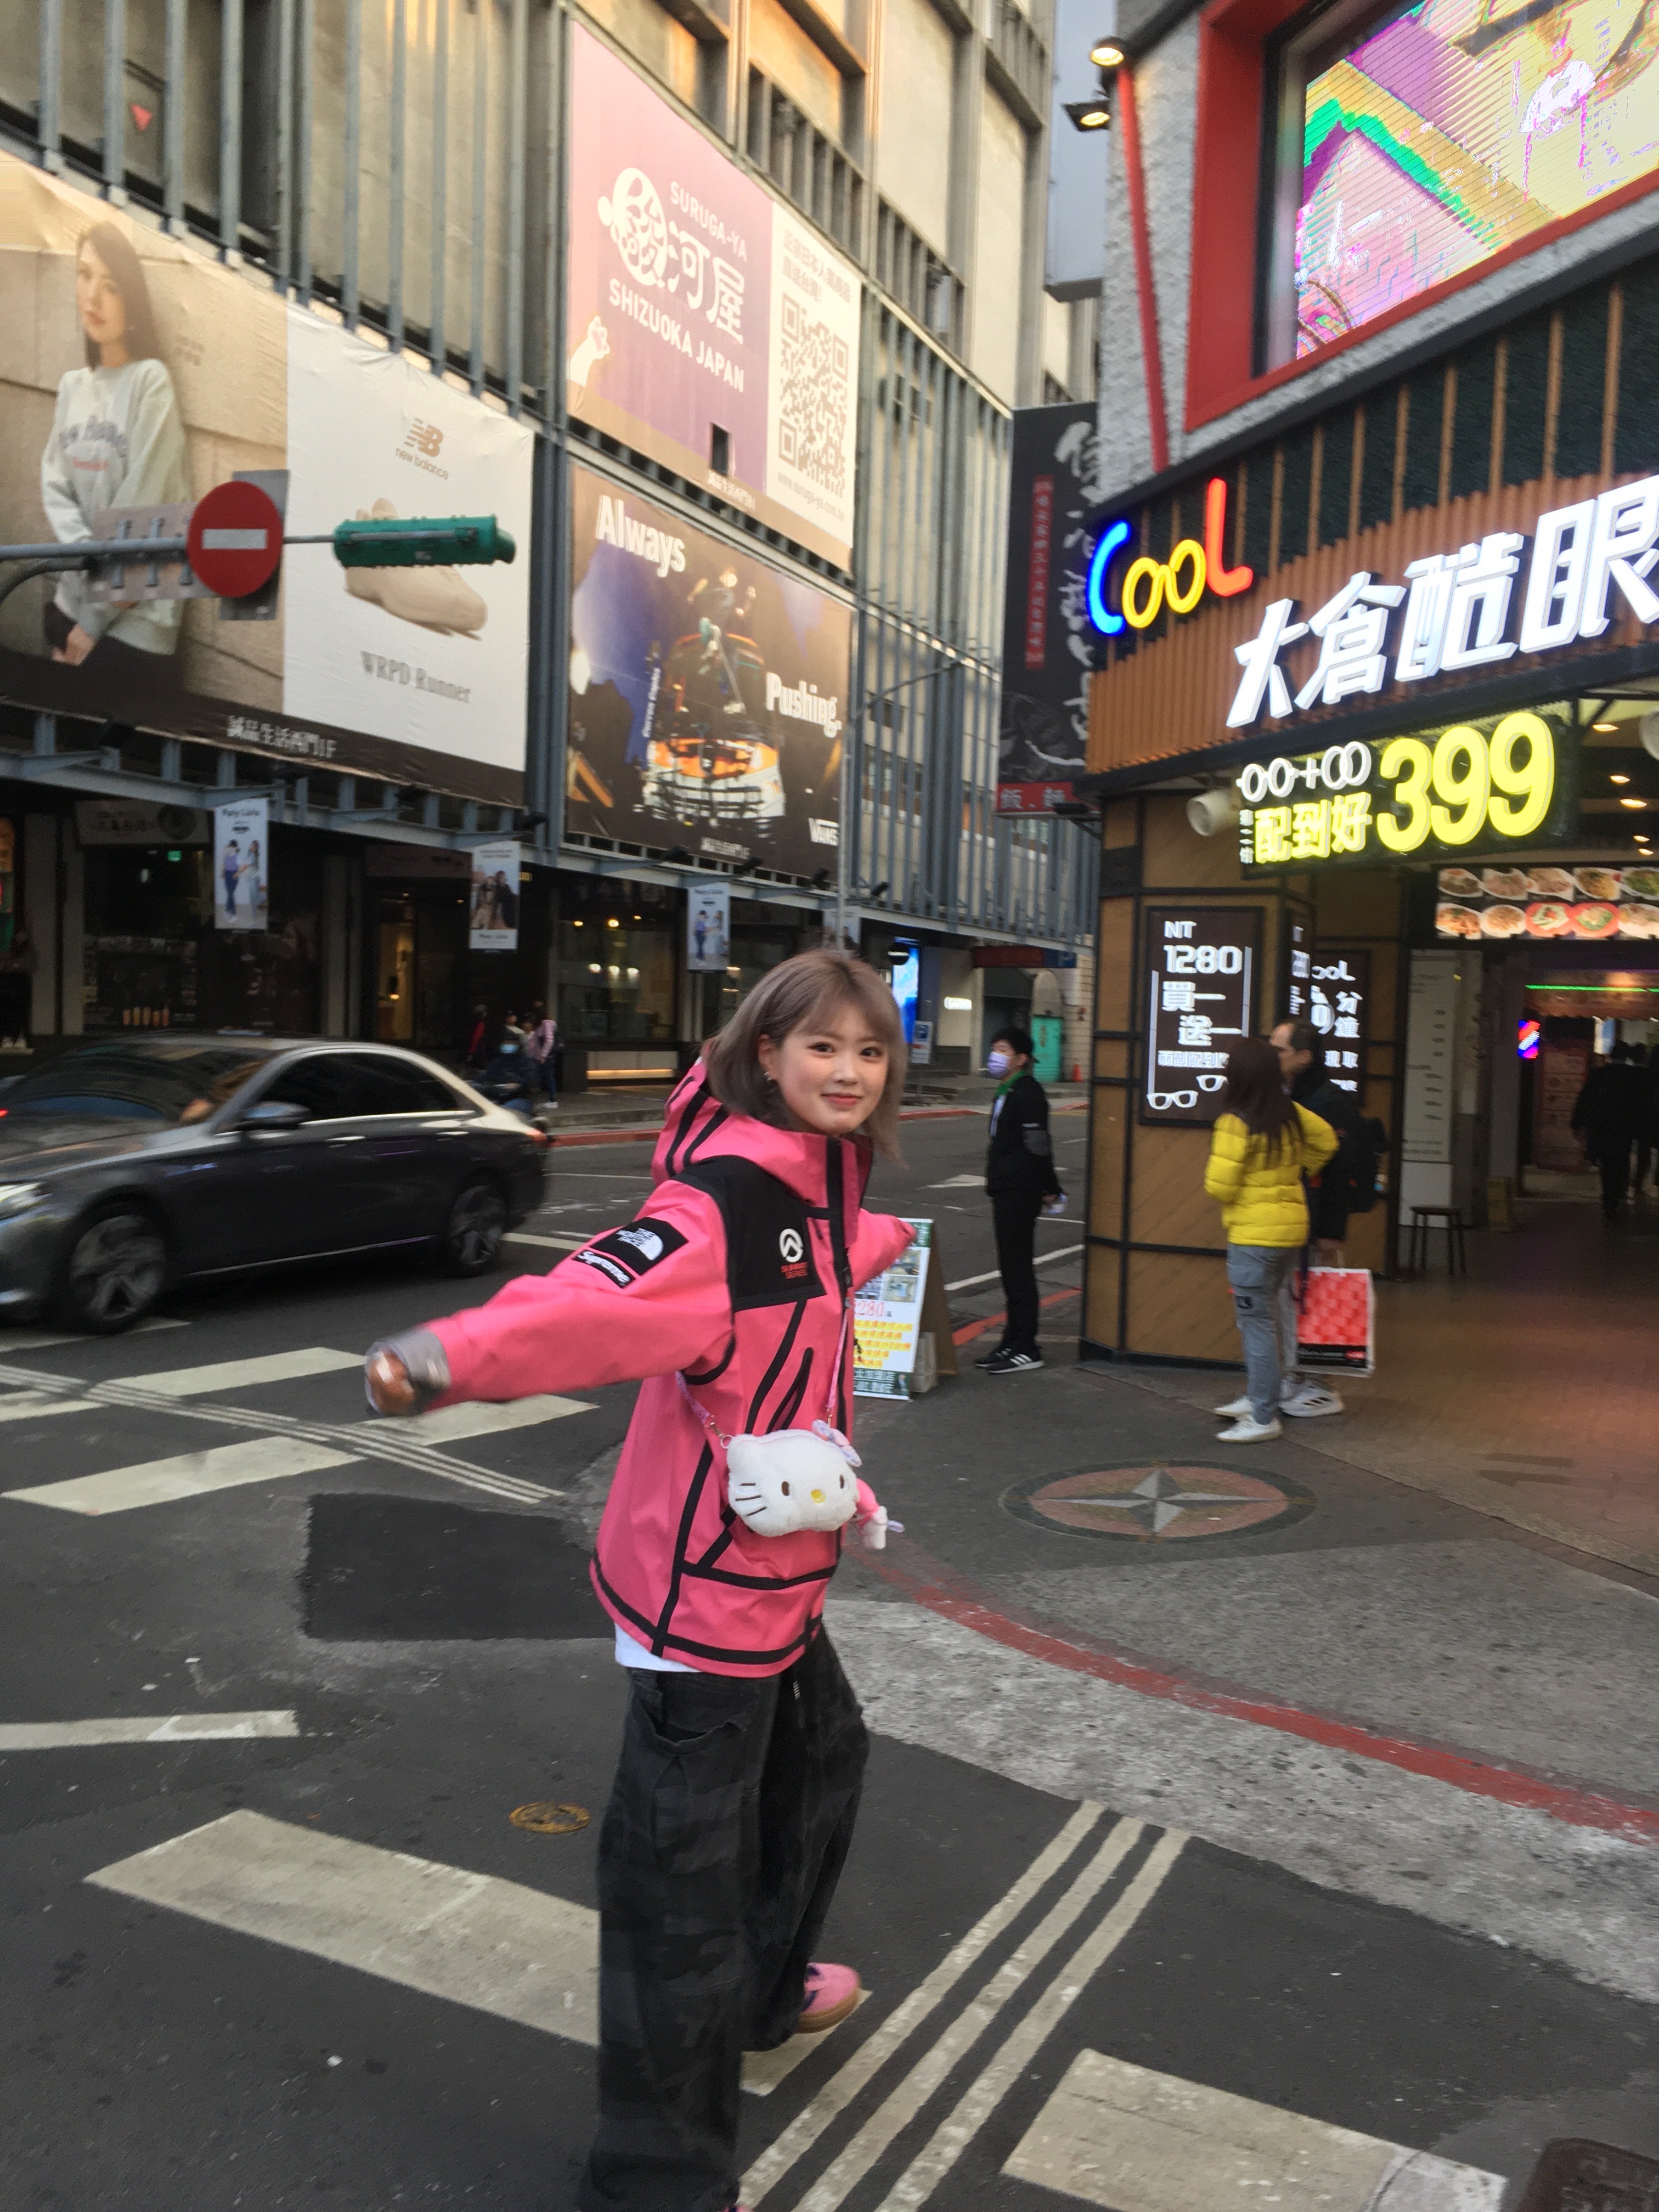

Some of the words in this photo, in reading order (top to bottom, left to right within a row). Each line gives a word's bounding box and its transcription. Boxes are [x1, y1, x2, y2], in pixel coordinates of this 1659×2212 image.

[670, 181, 748, 262] SURUGA-YA
[608, 278, 693, 358] SHIZUOKA
[696, 341, 744, 393] JAPAN
[395, 448, 414, 462] new
[415, 455, 449, 480] balance
[595, 495, 686, 577] Always
[1226, 475, 1659, 729] 大倉酷眼
[360, 651, 411, 685] WRPD
[415, 667, 472, 703] Runner
[1377, 712, 1555, 852] 399
[1254, 792, 1373, 864] 配到好
[1164, 921, 1197, 939] NT
[1163, 945, 1243, 974] 1280
[1162, 981, 1227, 1012] 買一
[1178, 1014, 1243, 1047] 送一
[578, 1251, 630, 1283] Supreme
